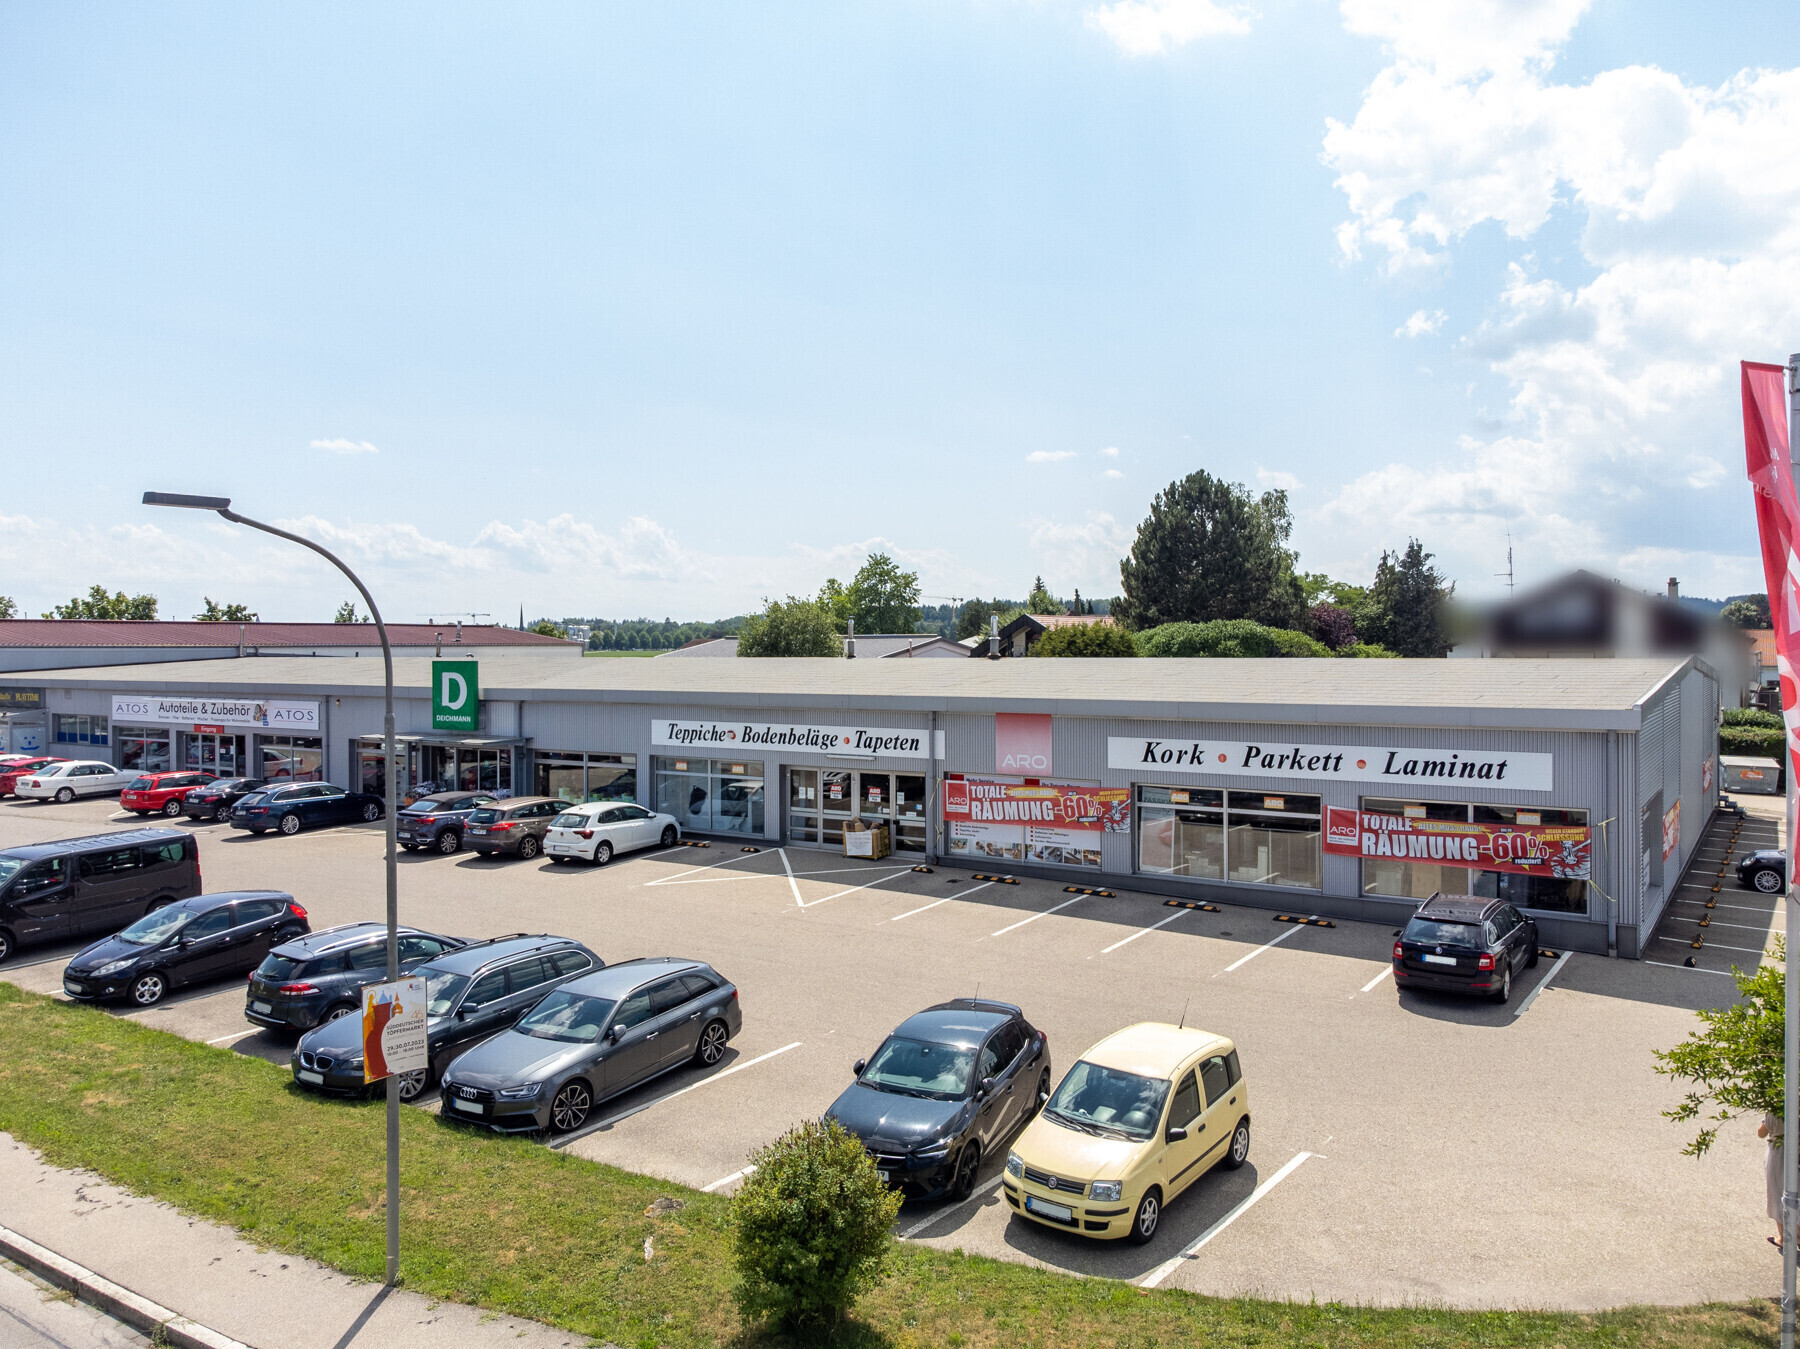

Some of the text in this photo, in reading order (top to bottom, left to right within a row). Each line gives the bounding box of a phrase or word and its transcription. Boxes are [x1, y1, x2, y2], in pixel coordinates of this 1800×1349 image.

[442, 672, 467, 710] D
[116, 704, 149, 713] ATOS
[159, 702, 251, 716] Autoteile & Zubehör
[274, 710, 314, 720] ATOS
[668, 723, 920, 753] Teppiche Bodenbeläge Tapeten
[1002, 754, 1047, 769] ARO
[1141, 741, 1508, 780] Kork Parkett Laminat
[970, 785, 1007, 799] TOTALE
[971, 795, 1103, 820] RÄUMUNG -60%
[1265, 799, 1283, 807] ARO
[1362, 815, 1412, 831] TOTALE
[1418, 822, 1438, 831] ALLES
[1330, 826, 1356, 835] ARO
[1536, 833, 1585, 841] SCHLIESSUNG
[1362, 830, 1550, 861] RÄUMUNG -60%
[386, 1019, 424, 1031] SÜDDEUTSCHER
[386, 1025, 424, 1036] TÖPFERMARKT
